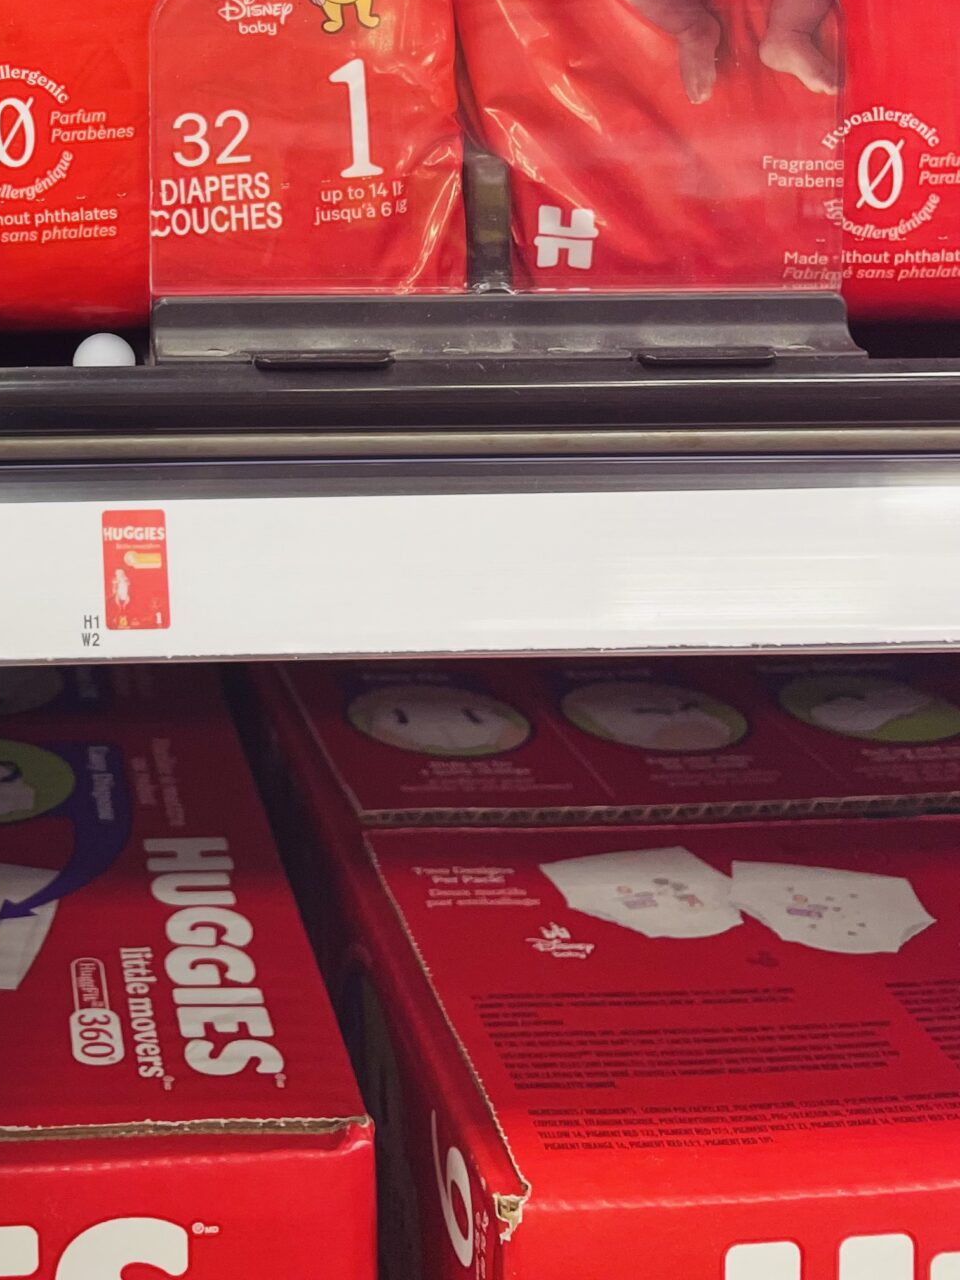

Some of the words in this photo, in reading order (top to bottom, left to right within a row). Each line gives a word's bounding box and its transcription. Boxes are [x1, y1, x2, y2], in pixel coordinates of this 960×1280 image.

[238, 21, 277, 36] baby
[49, 110, 106, 126] Parfum
[328, 58, 384, 178] 1
[50, 125, 134, 143] Parabènes
[172, 109, 251, 167] 32
[763, 155, 844, 173] Fragrance
[159, 171, 270, 206] DIAPERS
[768, 173, 844, 187] Parabens
[321, 188, 342, 203] up
[347, 185, 365, 199] to
[369, 183, 388, 197] 14
[34, 207, 118, 227] phthalates
[150, 201, 283, 238] COUCHES
[314, 203, 376, 226] jusqu'à
[380, 202, 392, 216] 6
[1, 228, 38, 243] sans
[41, 224, 117, 244] phtalates
[784, 251, 828, 265] Made
[856, 267, 894, 279] sans
[104, 526, 165, 541] HUGGIES
[83, 615, 100, 629] H1
[82, 633, 100, 646] W2
[143, 836, 285, 1076] HUGGIES
[119, 946, 158, 995] little
[76, 1008, 116, 1059] 360
[128, 994, 165, 1079] movers
